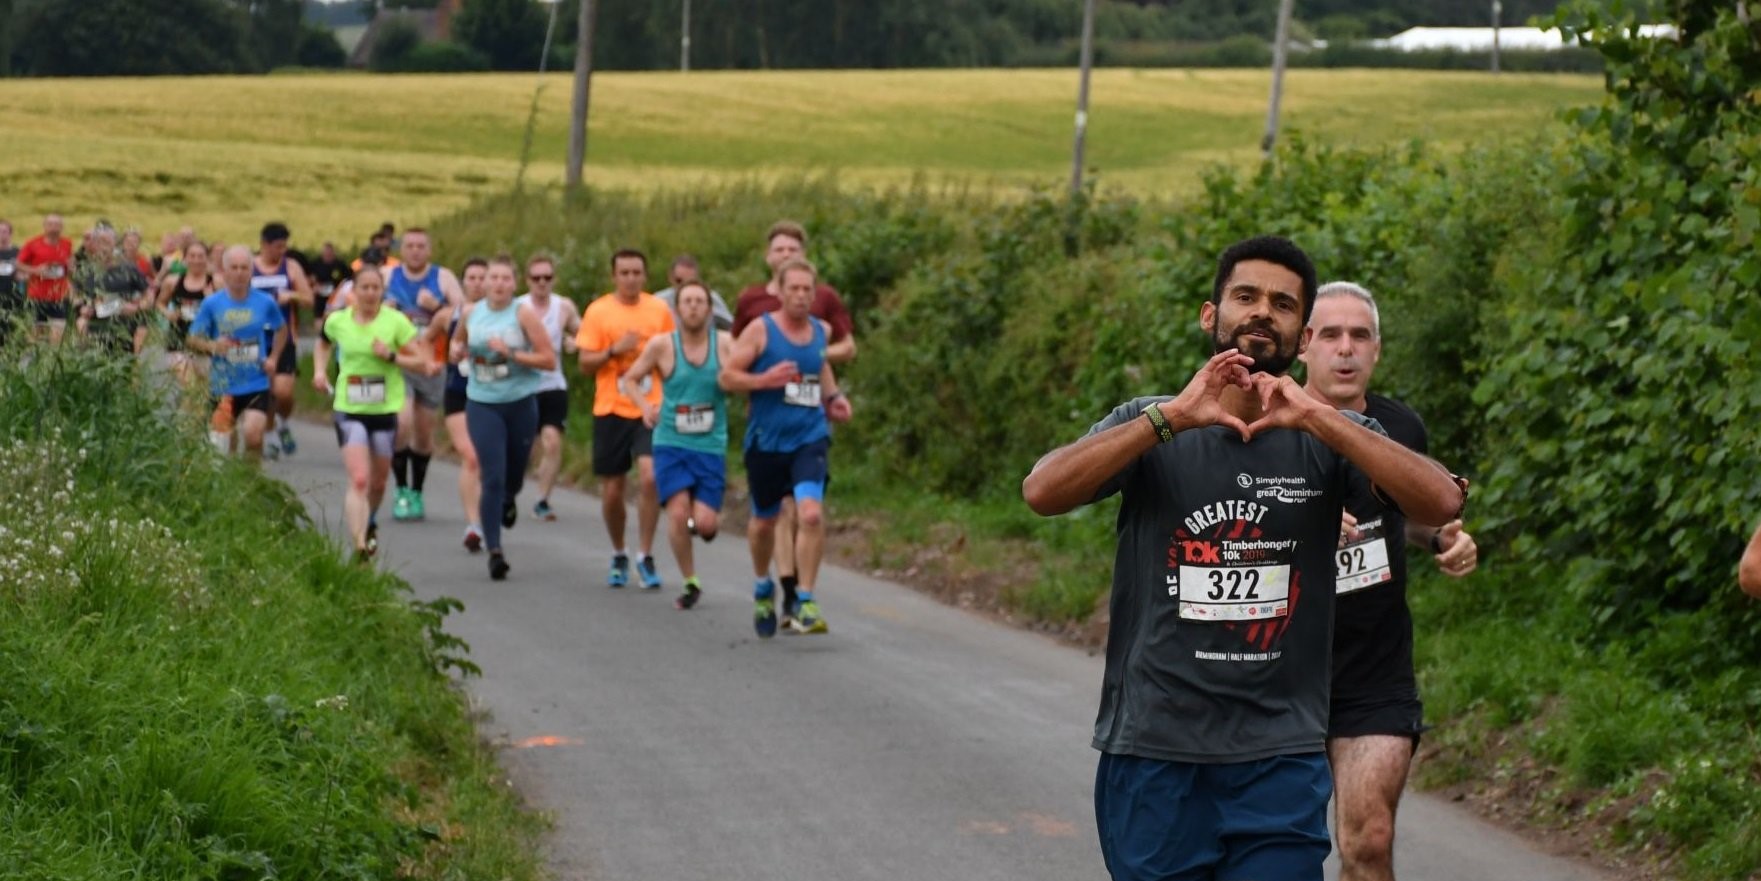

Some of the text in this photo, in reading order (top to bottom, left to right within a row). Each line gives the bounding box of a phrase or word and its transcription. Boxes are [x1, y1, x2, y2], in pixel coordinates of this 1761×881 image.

[1255, 477, 1306, 485] Simplyhealth
[1256, 489, 1277, 498] great
[1184, 499, 1269, 535] GREATEST
[1182, 540, 1221, 564] 10k
[1222, 550, 1265, 561] 10k 2019
[1207, 569, 1260, 600] 322
